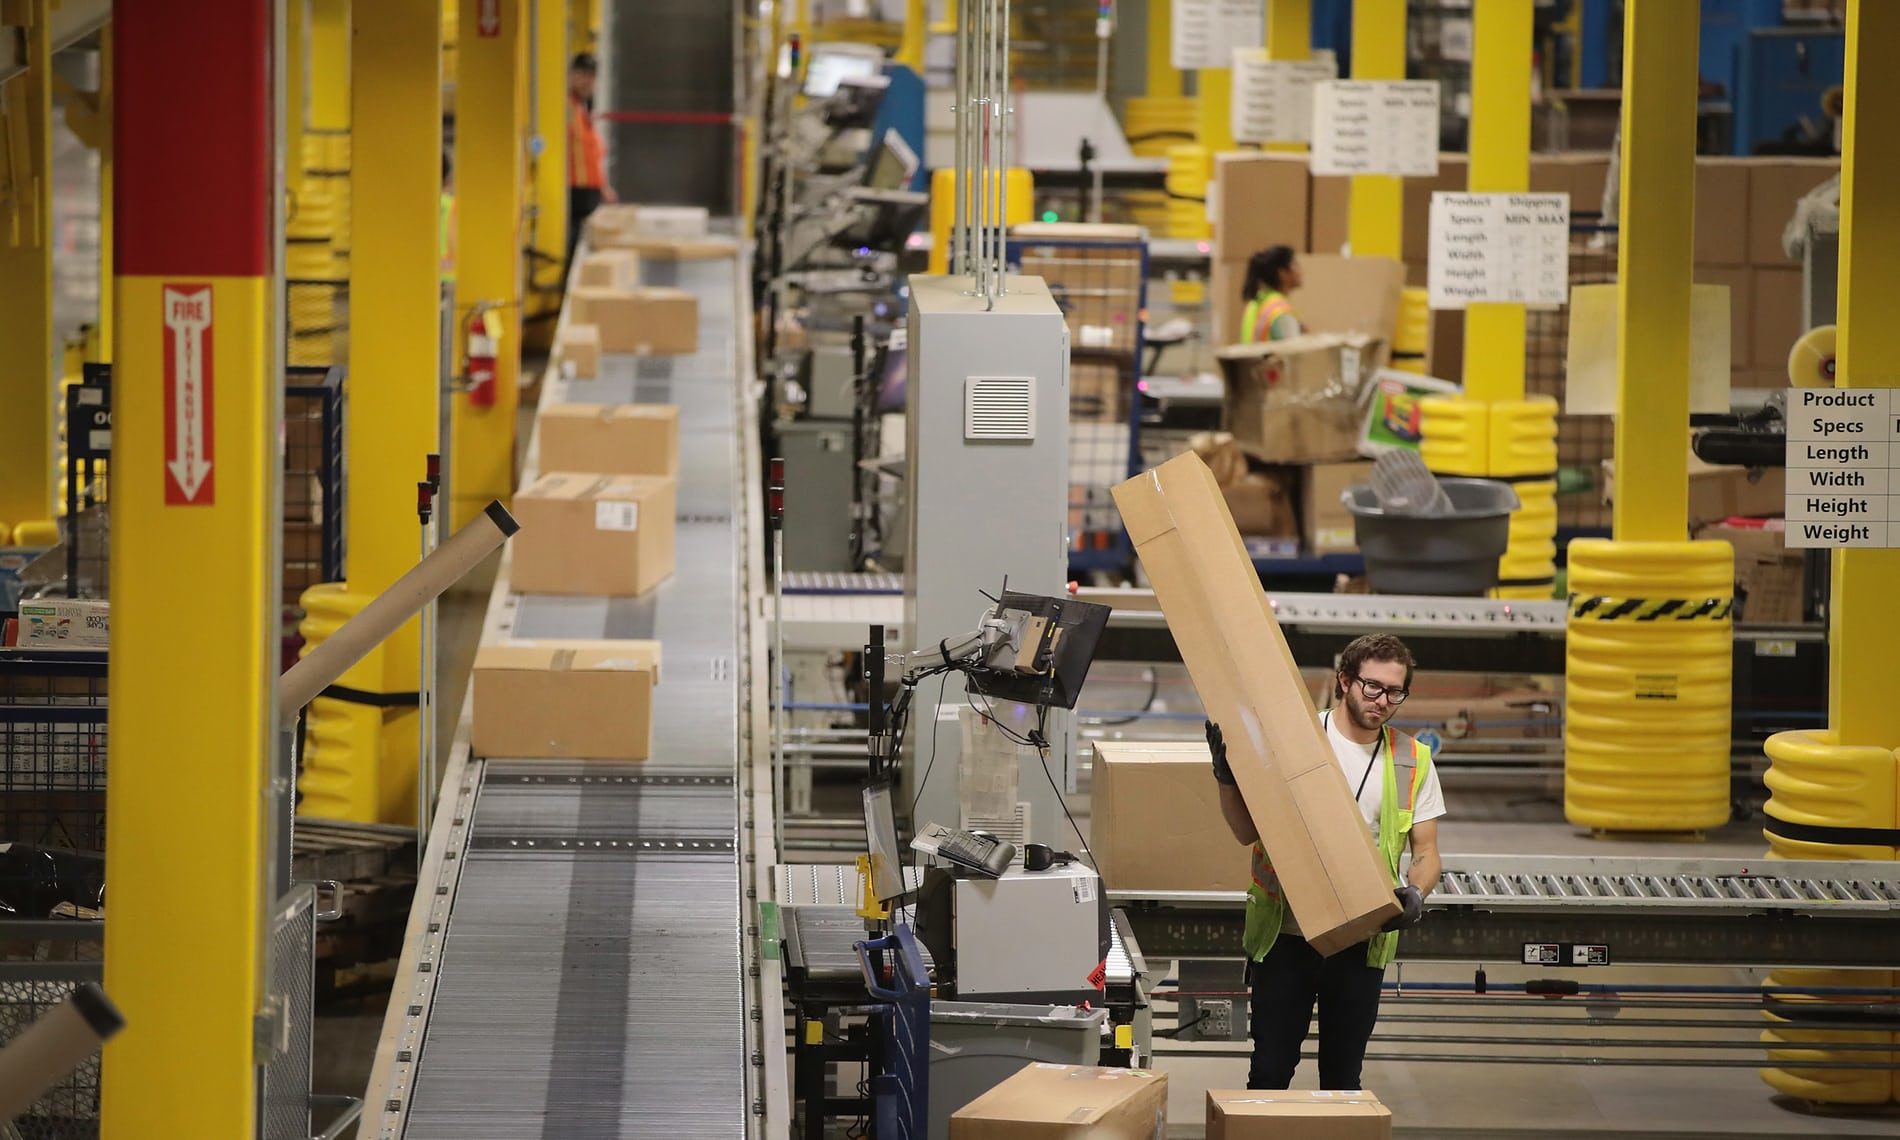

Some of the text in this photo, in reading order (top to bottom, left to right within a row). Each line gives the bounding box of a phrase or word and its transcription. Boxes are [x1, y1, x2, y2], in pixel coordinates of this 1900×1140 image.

[173, 301, 203, 321] FIRE
[185, 326, 194, 488] EXTINGUISHER
[1803, 391, 1875, 407] Product
[1812, 418, 1864, 436] Specs
[1806, 445, 1869, 463] Length
[1809, 471, 1865, 486] Width
[1806, 498, 1868, 517] Height
[1803, 525, 1870, 543] Weight
